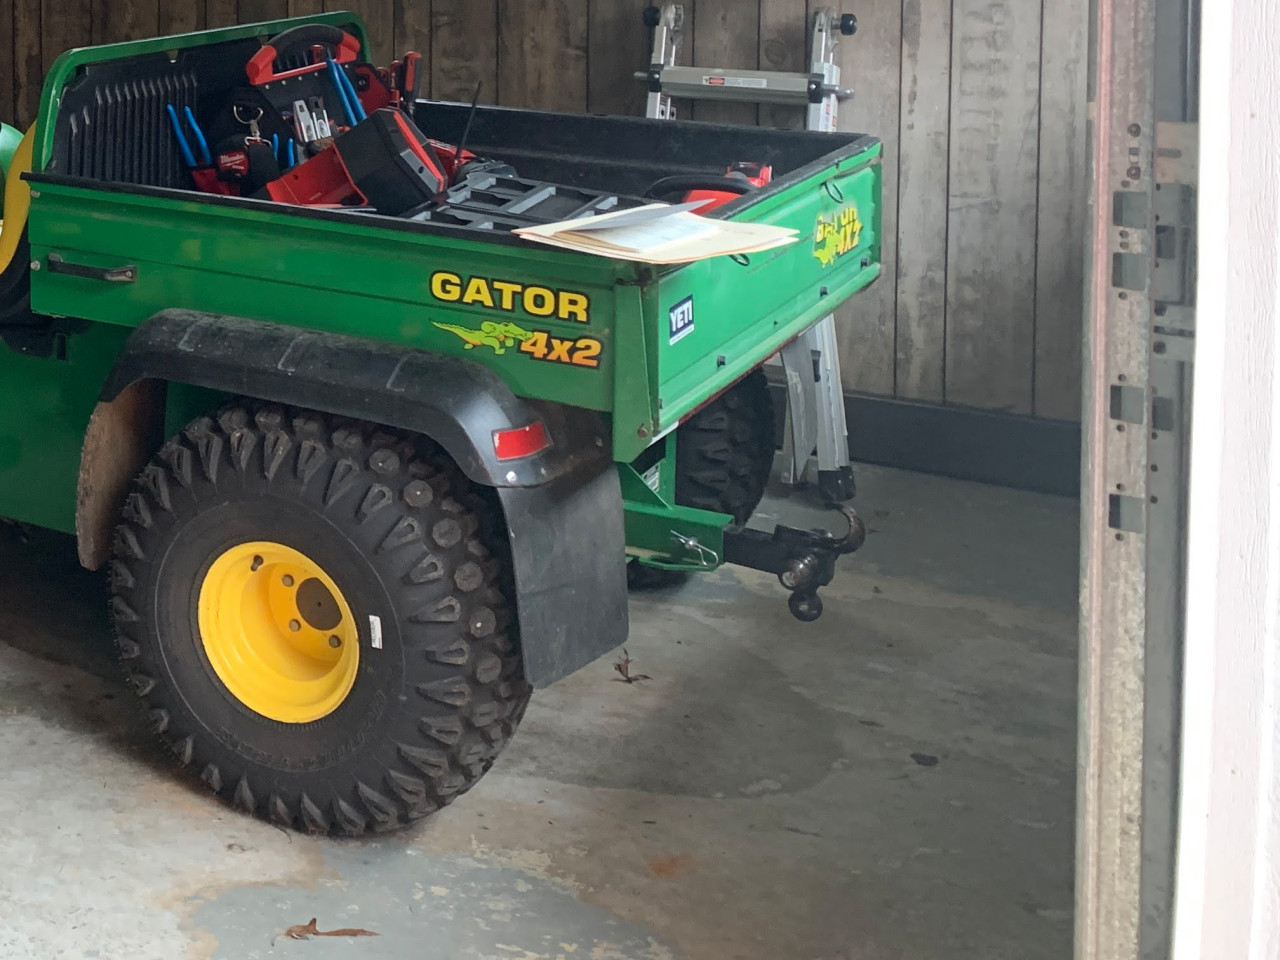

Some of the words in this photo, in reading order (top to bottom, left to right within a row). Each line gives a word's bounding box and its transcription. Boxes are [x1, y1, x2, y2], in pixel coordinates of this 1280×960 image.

[429, 269, 591, 324] GATOR
[669, 299, 693, 333] YETI
[519, 330, 604, 369] 4x2
